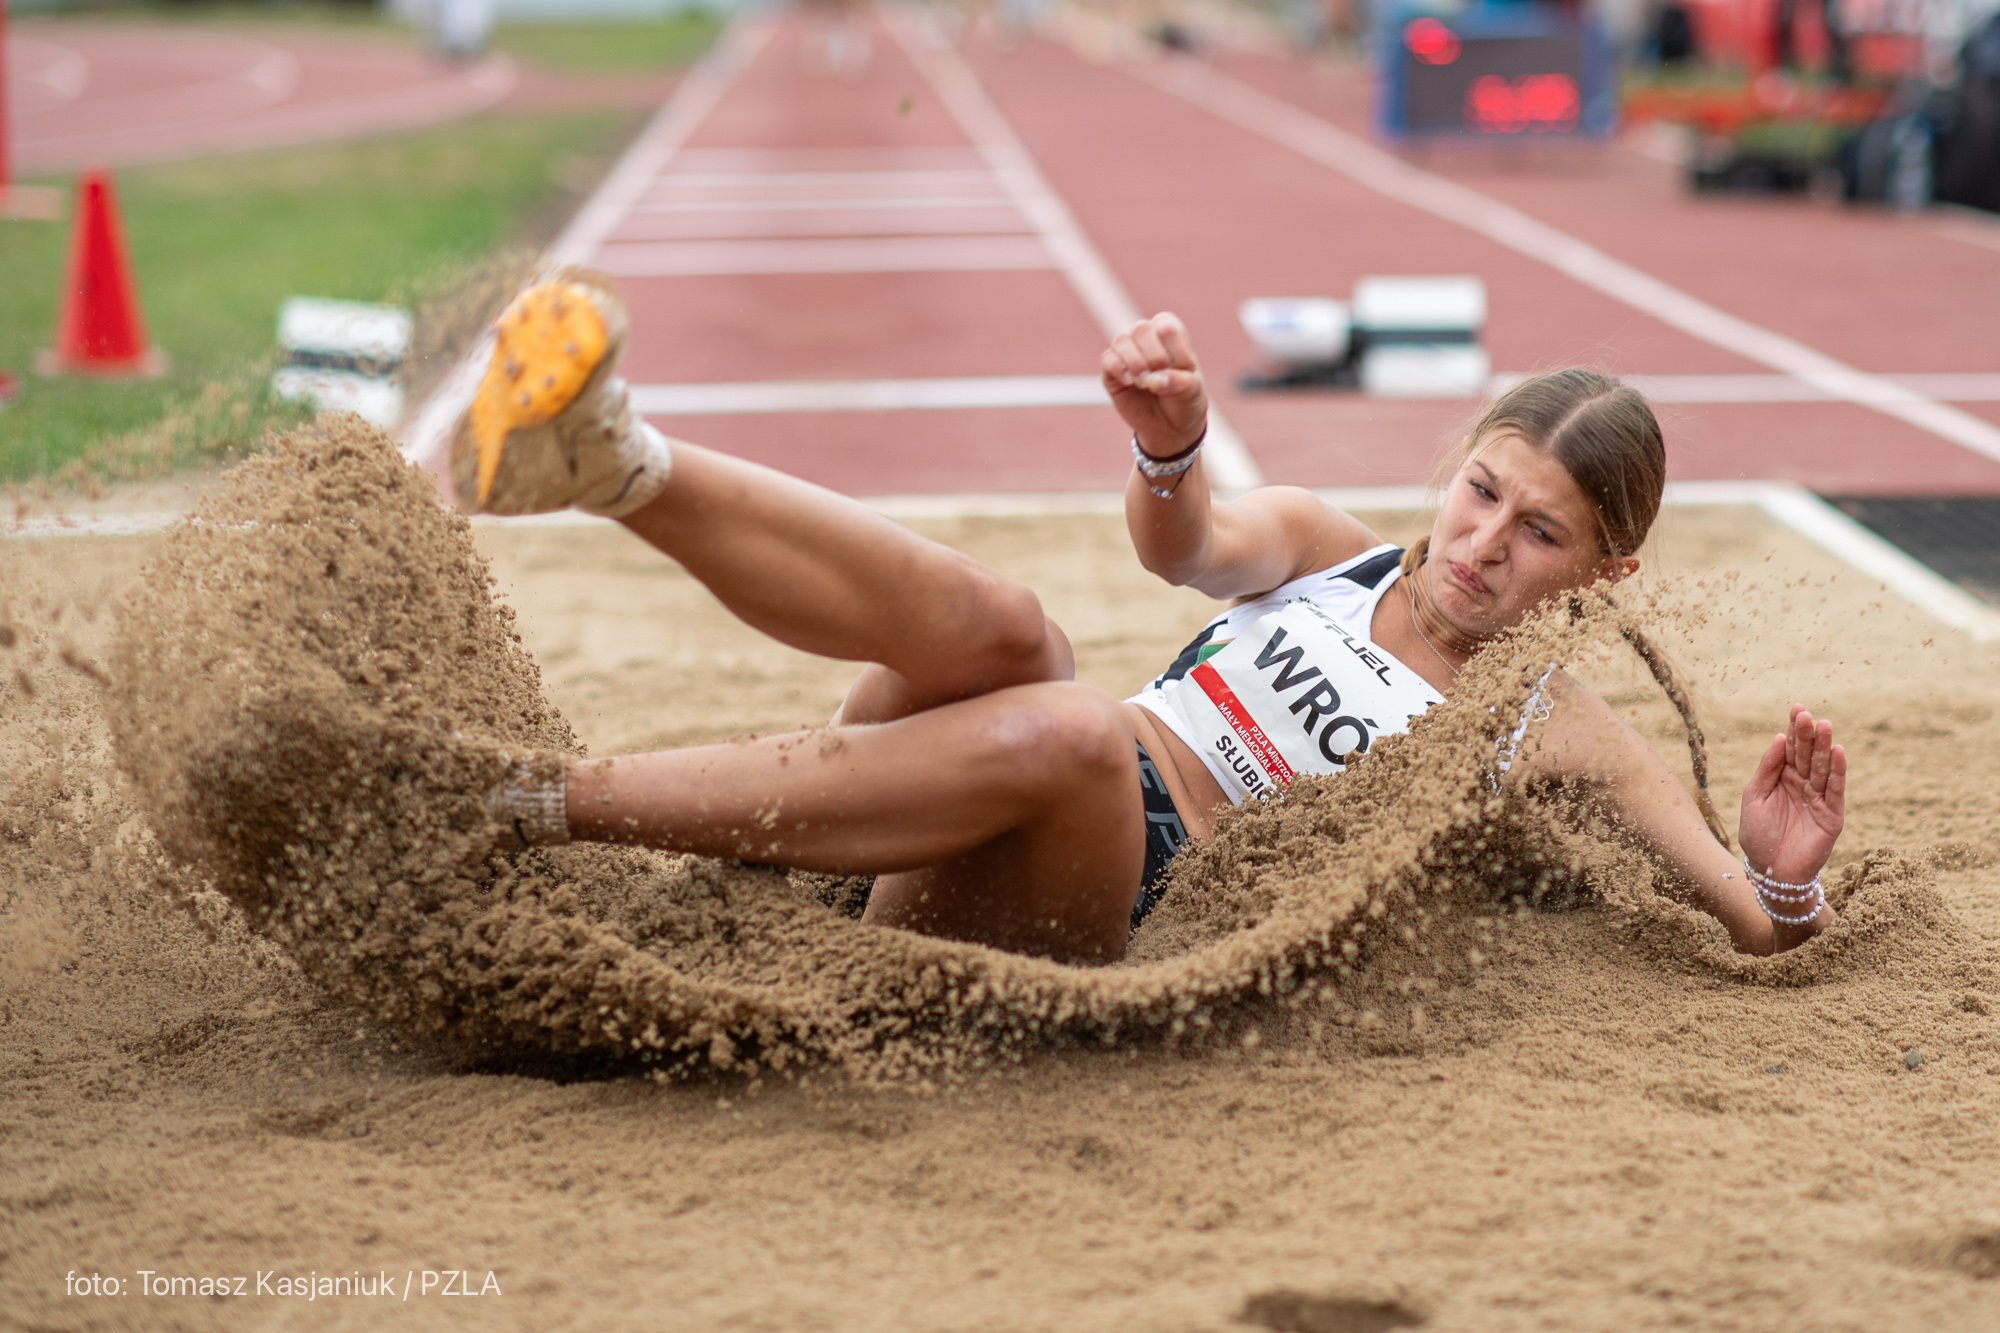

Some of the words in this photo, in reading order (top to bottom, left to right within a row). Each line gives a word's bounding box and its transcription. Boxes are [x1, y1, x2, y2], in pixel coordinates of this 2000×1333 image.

[1218, 702, 1240, 726] MAŁY
[1236, 725, 1272, 771] MEMORIAŁ
[1250, 726, 1268, 748] PZLA
